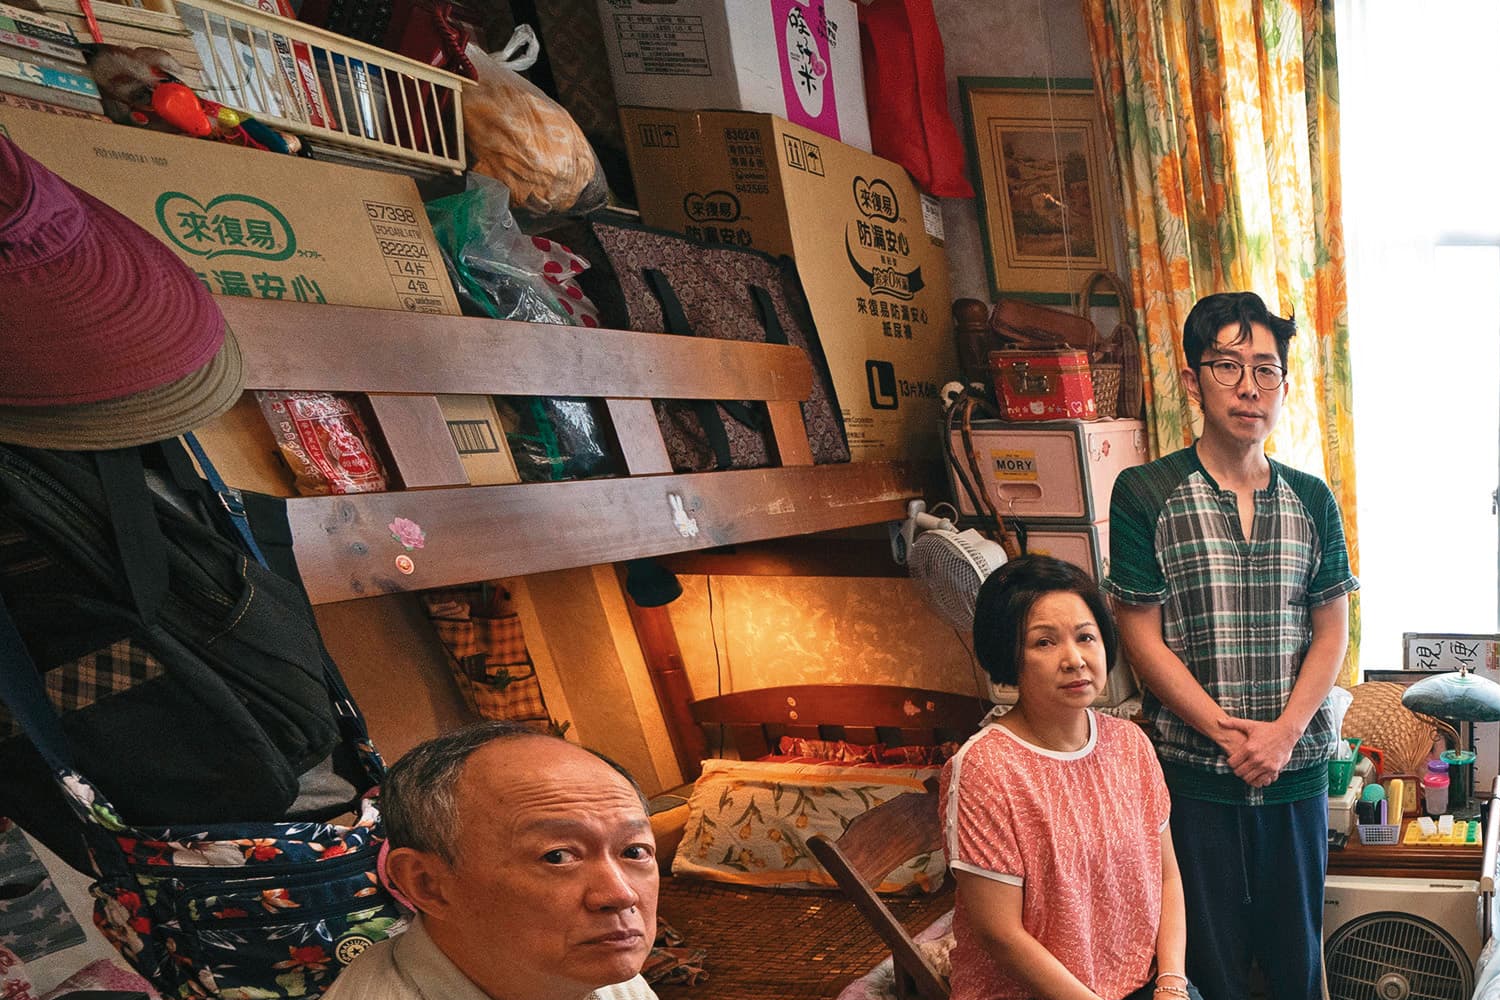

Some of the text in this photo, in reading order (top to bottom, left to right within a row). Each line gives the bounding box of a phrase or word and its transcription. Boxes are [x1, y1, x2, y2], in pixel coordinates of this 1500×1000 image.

[860, 188, 893, 217] 來復易
[366, 203, 416, 224] 57398
[176, 211, 276, 250] 來復易
[855, 219, 911, 256] 防漏安心
[380, 240, 428, 258] 822234
[394, 260, 426, 276] 14片
[407, 279, 430, 294] 4包
[856, 297, 929, 324] 來復易防漏安心
[996, 459, 1034, 471] MORY
